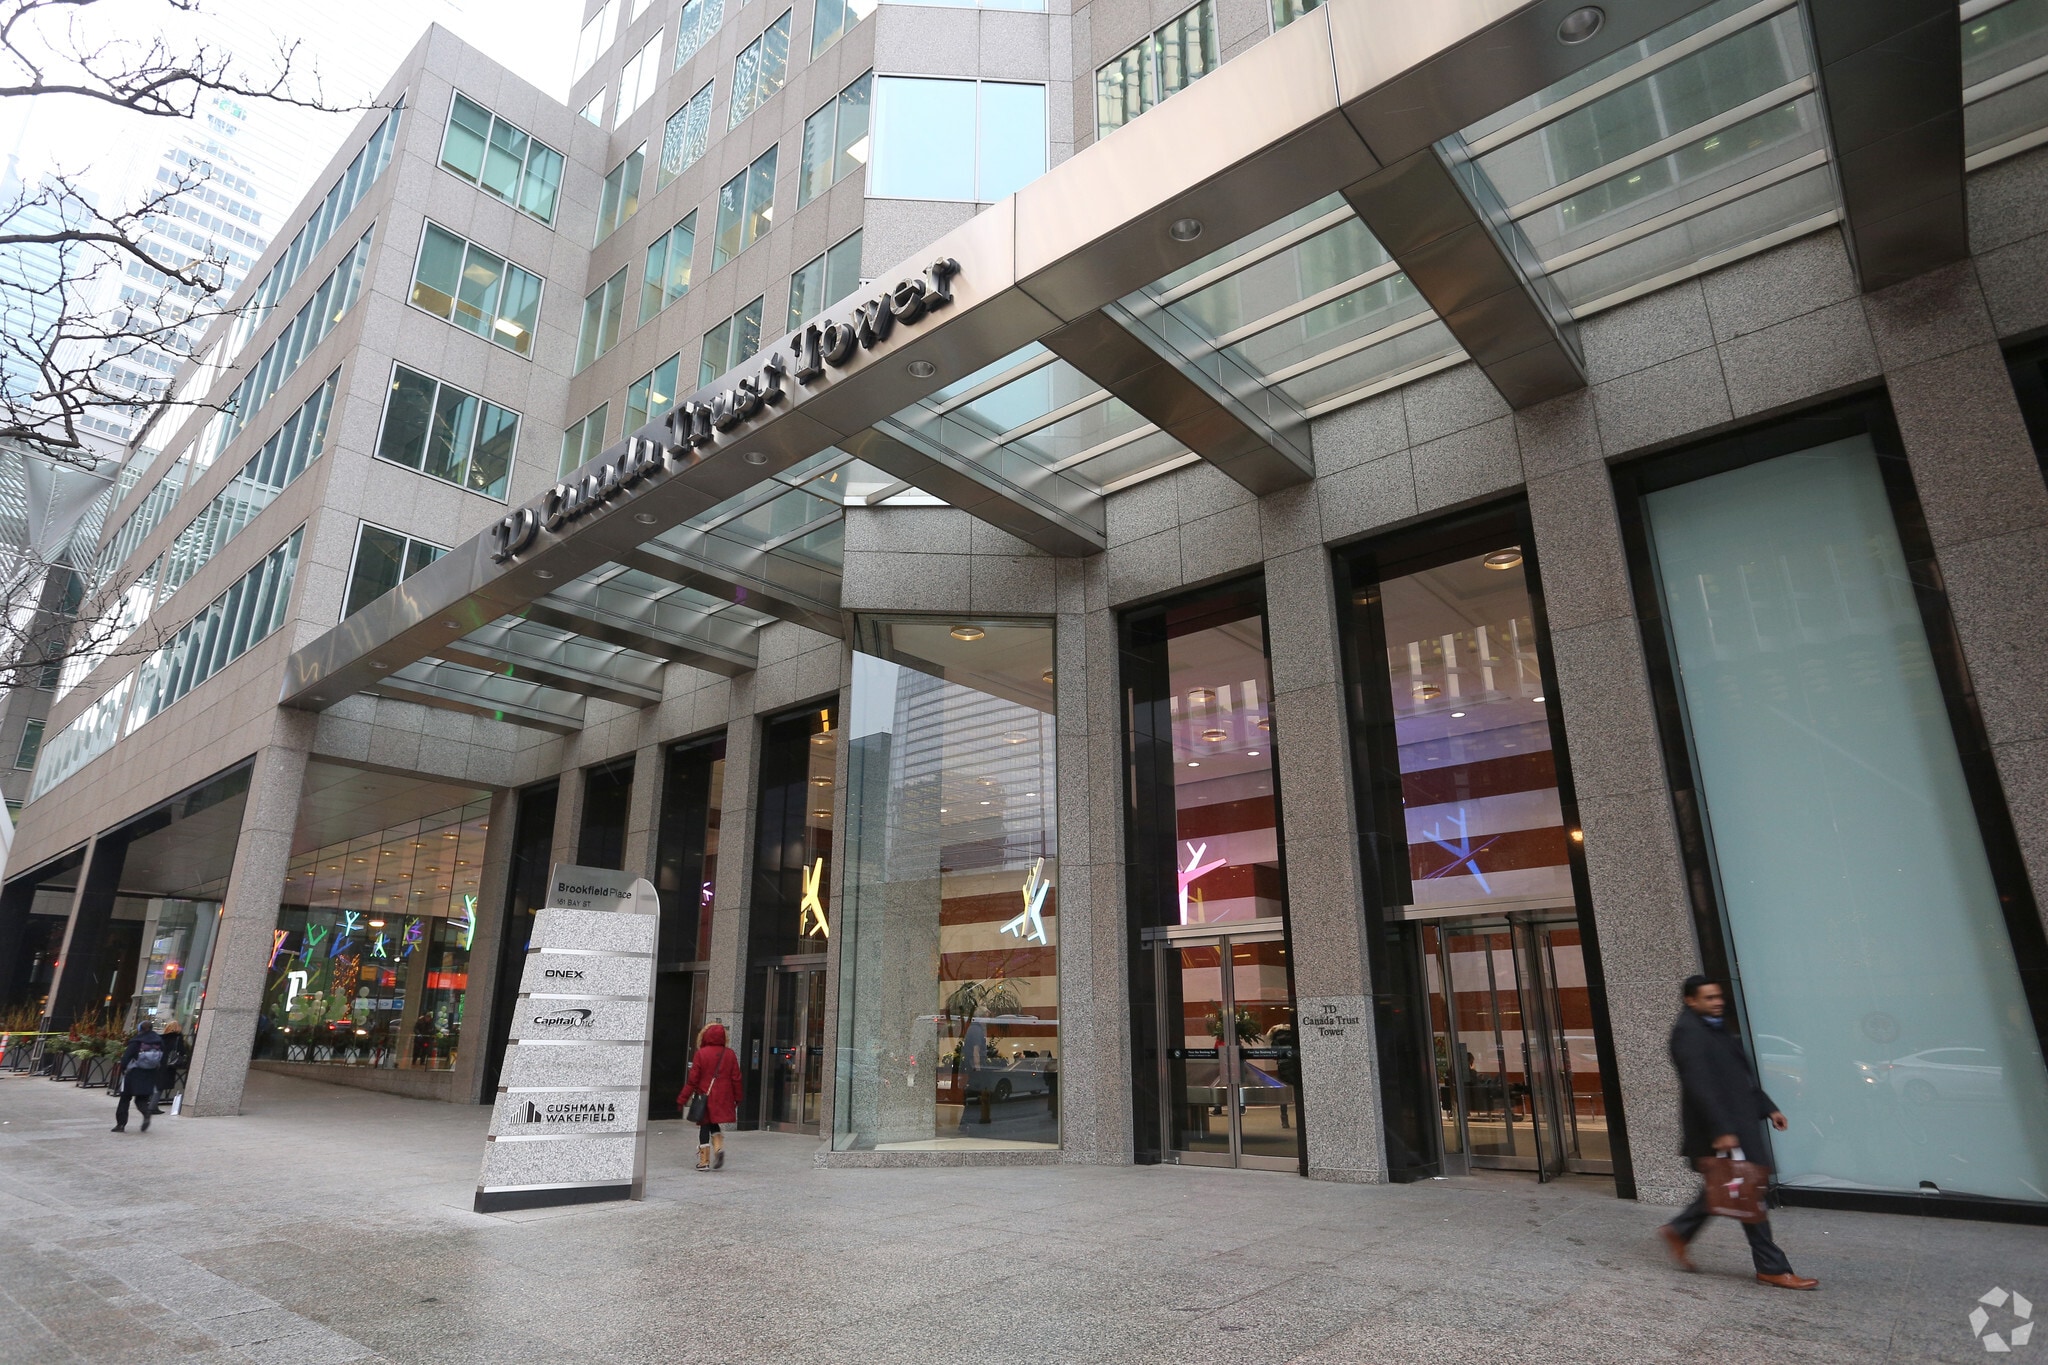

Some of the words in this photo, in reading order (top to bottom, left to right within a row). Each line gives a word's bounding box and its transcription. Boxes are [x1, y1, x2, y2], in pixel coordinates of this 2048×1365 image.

[490, 507, 540, 564] TD
[539, 436, 665, 533] Canada
[665, 352, 786, 460] Trust
[790, 256, 961, 386] Tower
[558, 882, 609, 896] Brookfield
[567, 899, 581, 907] BAY
[582, 900, 592, 908] ST
[545, 969, 584, 979] ONEX
[1323, 1004, 1337, 1014] TD
[1303, 1015, 1335, 1026] Canada
[1335, 1015, 1360, 1025] Trust
[1319, 1027, 1344, 1036] Tower
[547, 1104, 605, 1113] CUSHMAN
[607, 1103, 616, 1112] &
[546, 1113, 616, 1123] WAKEFIELD
